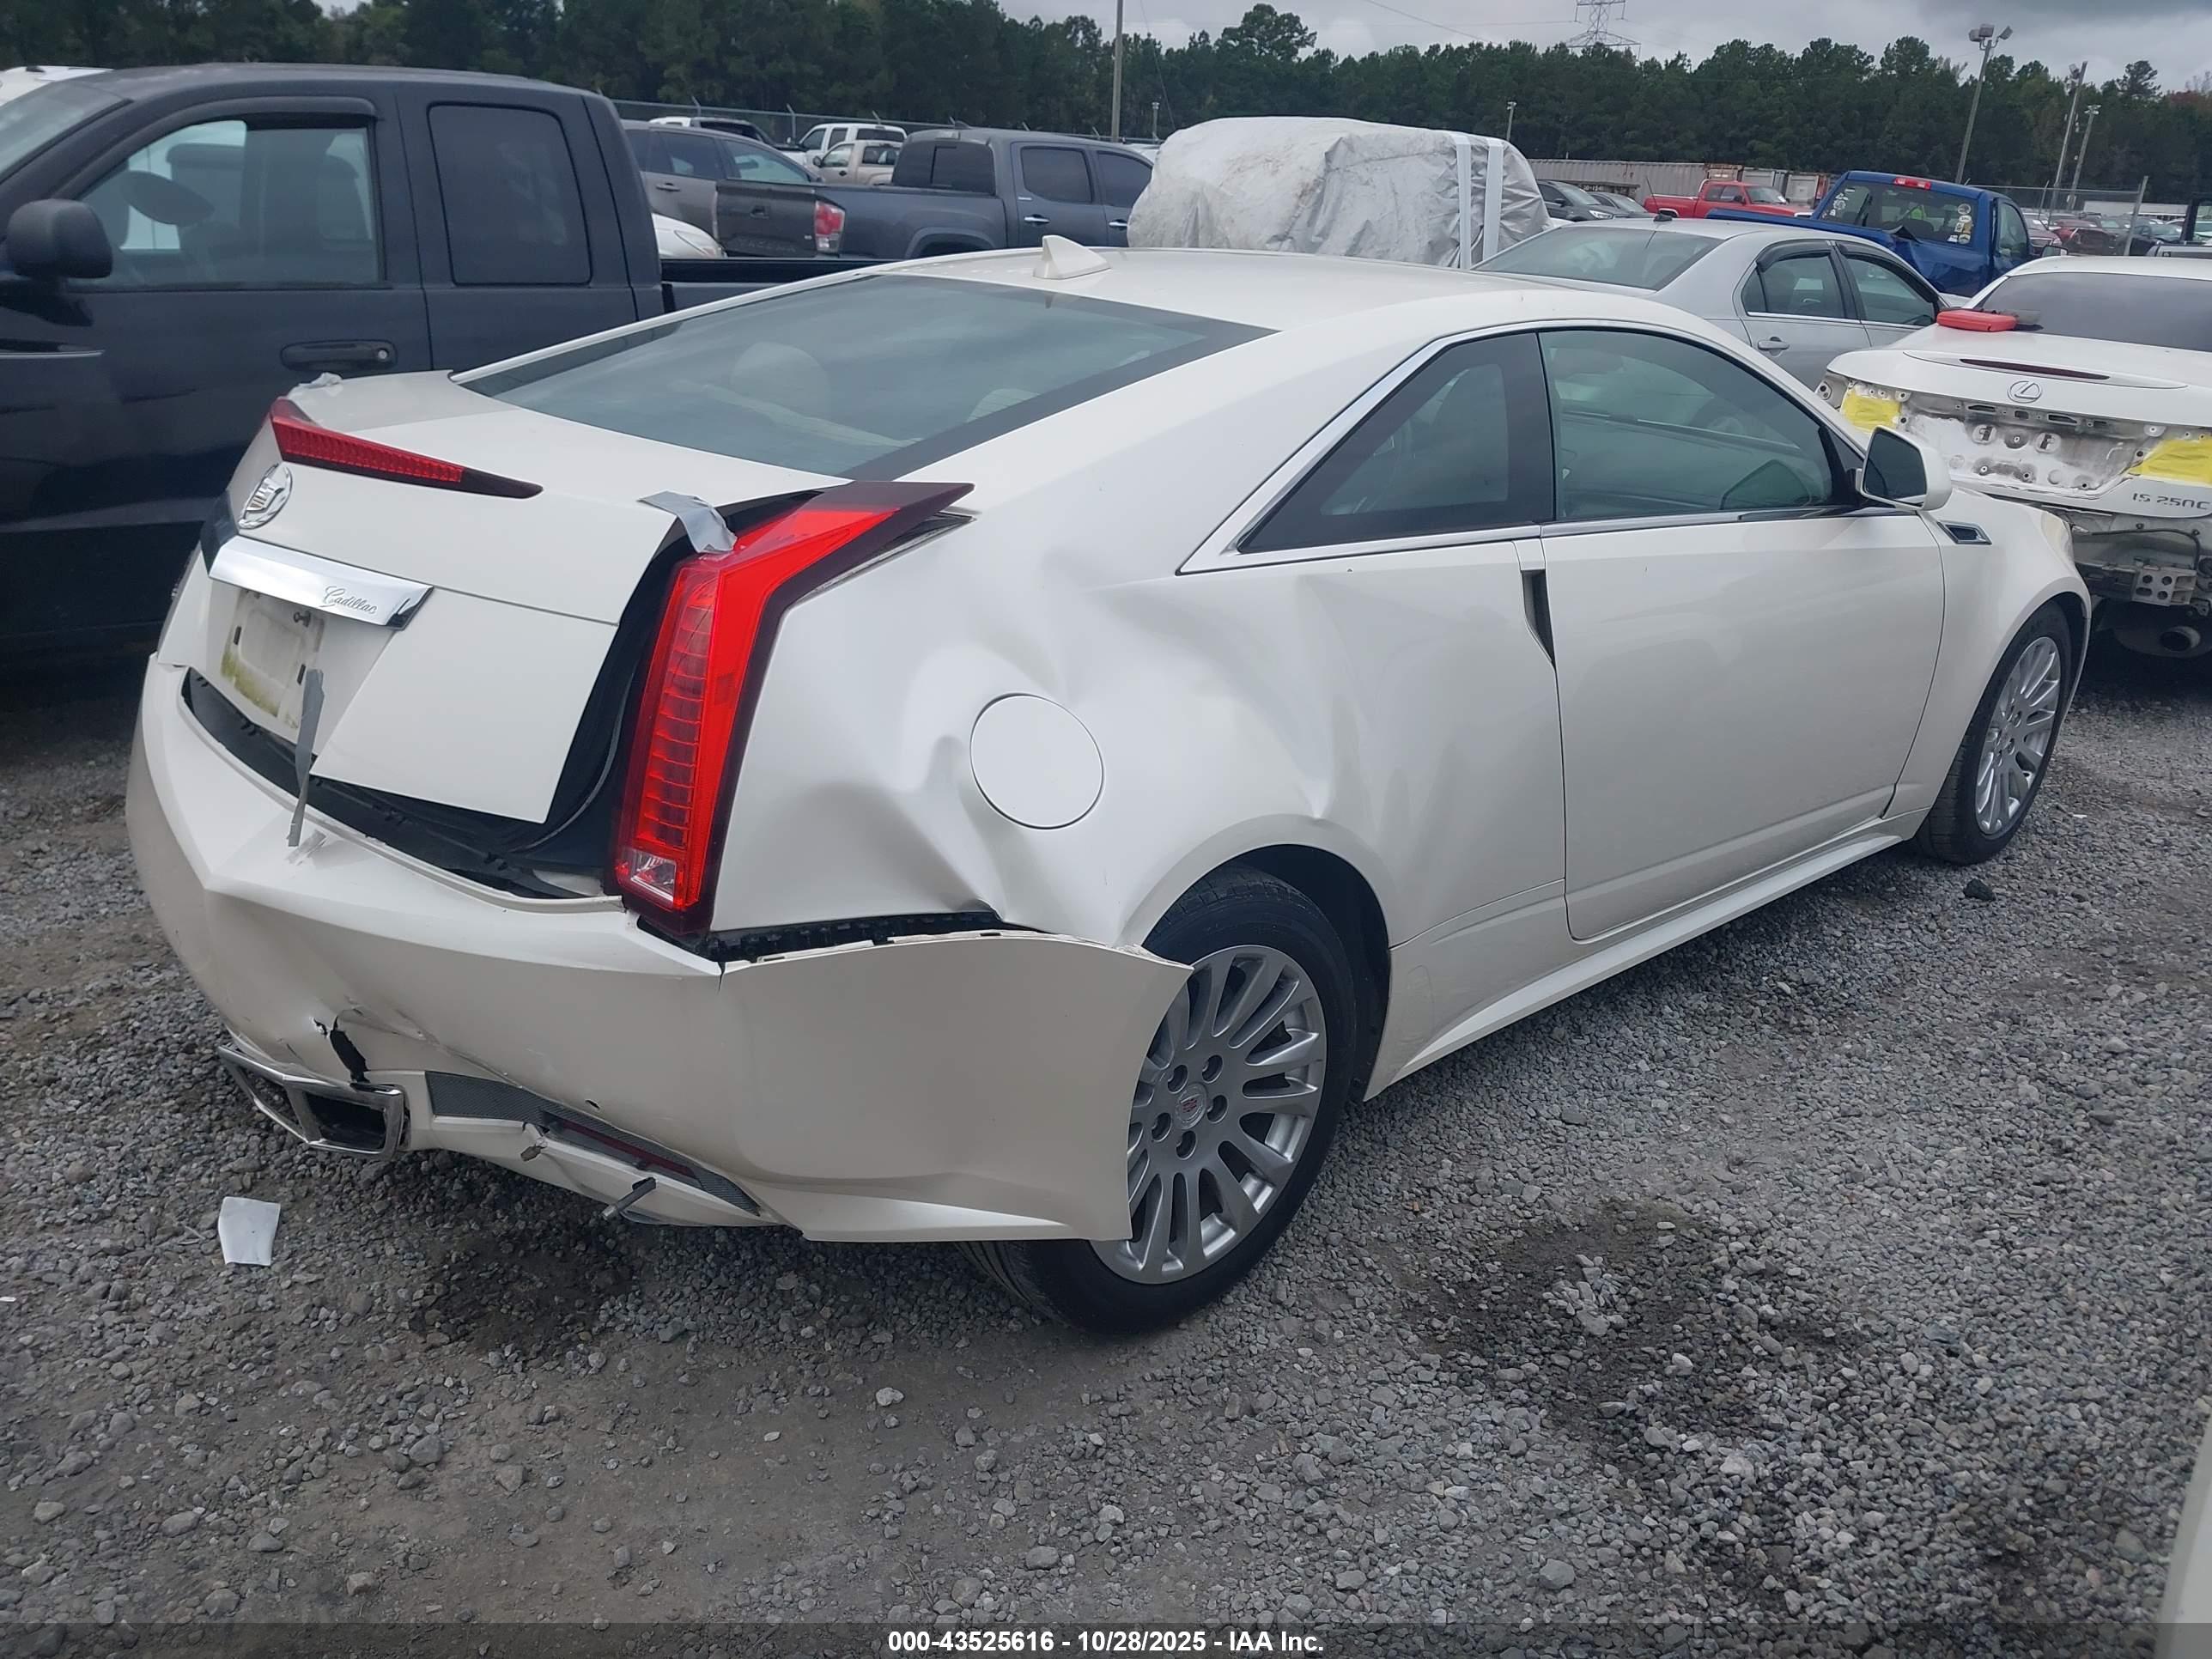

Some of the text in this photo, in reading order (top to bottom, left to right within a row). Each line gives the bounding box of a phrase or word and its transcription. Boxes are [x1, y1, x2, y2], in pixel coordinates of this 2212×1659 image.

[2132, 493, 2211, 510] IS 250C
[320, 586, 377, 614] Cadillac
